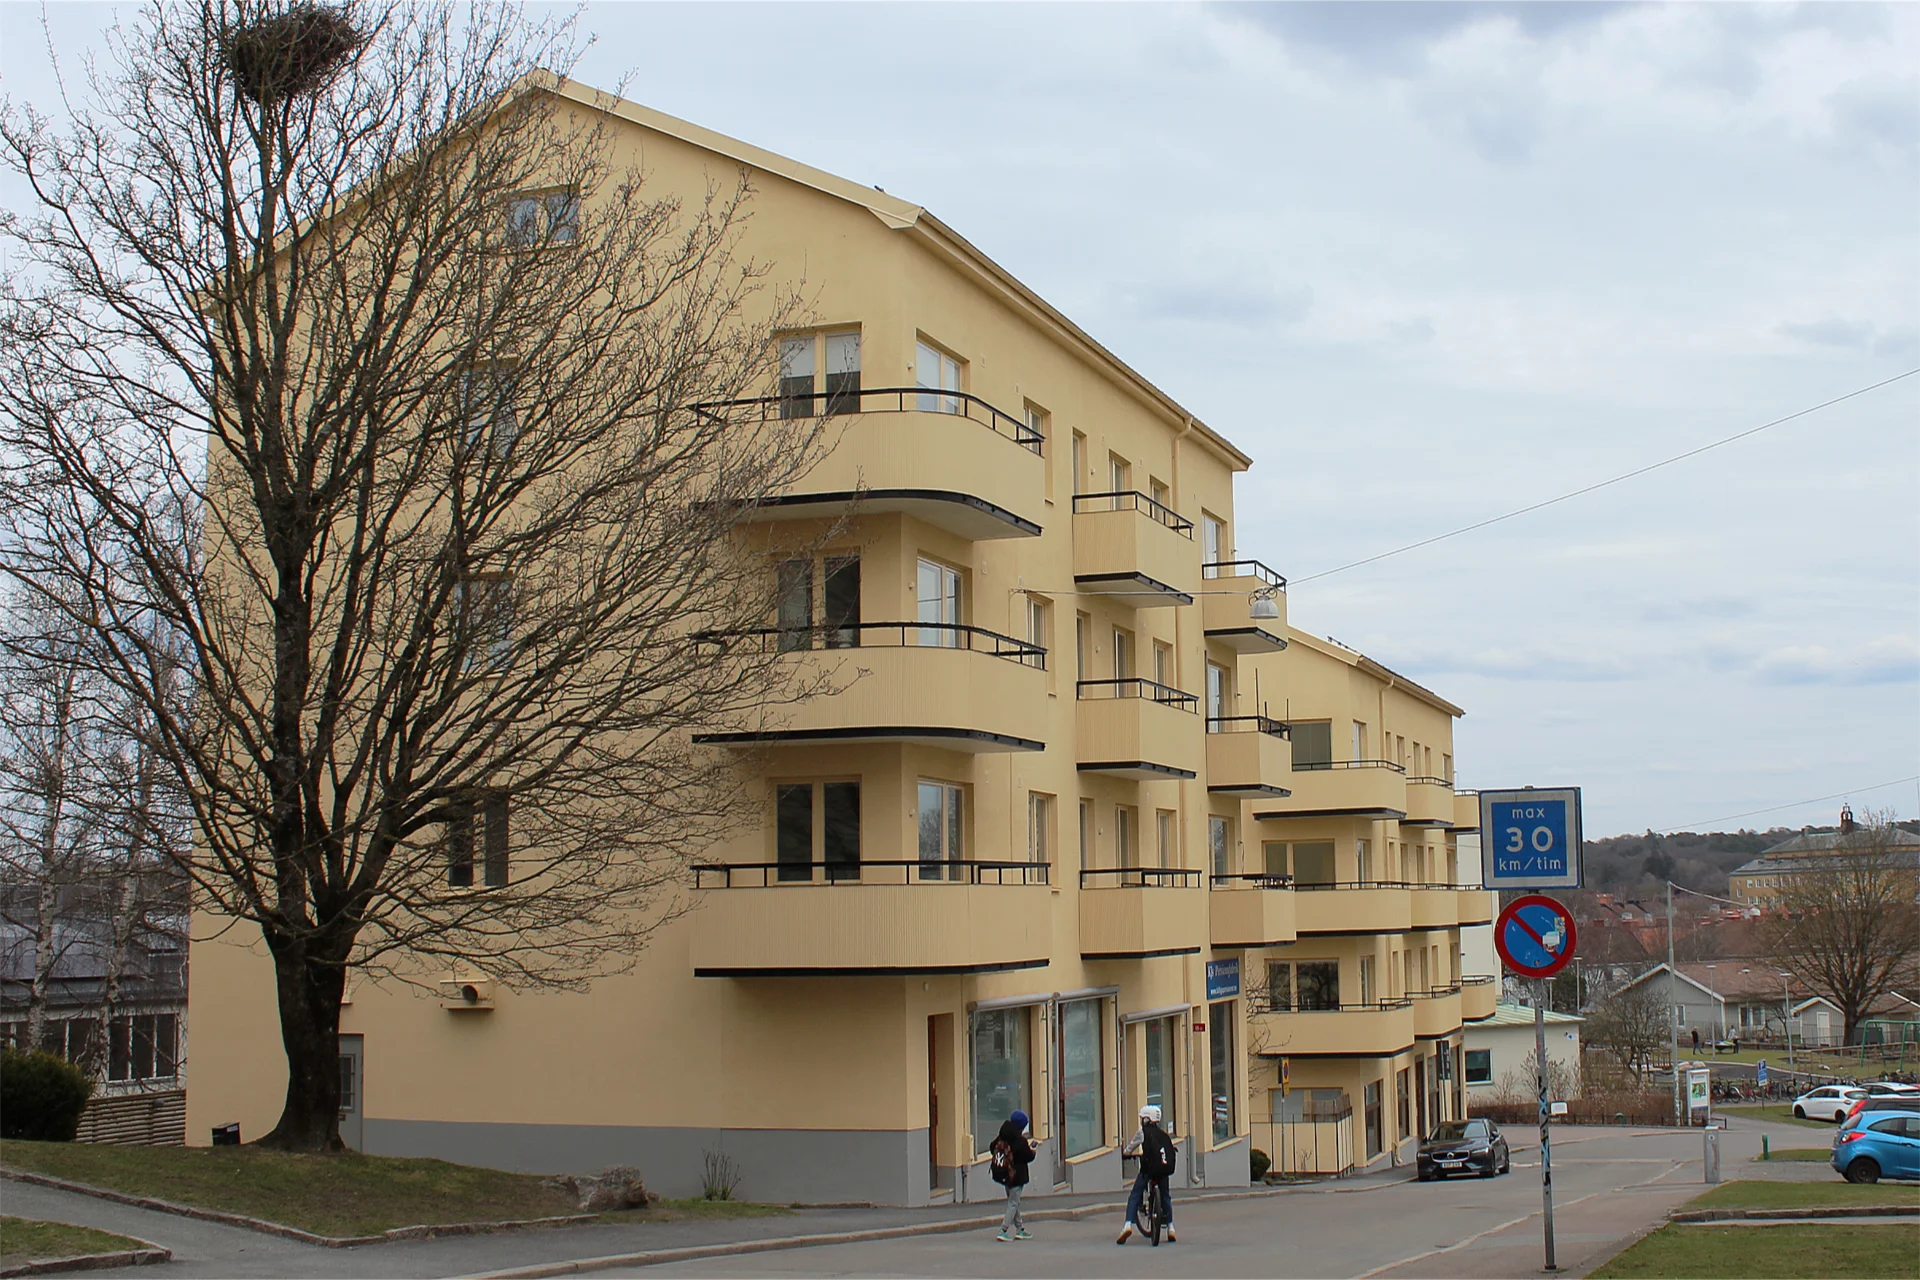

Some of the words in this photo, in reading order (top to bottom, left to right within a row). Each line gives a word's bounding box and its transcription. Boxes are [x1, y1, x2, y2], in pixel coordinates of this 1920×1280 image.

[1512, 808, 1545, 819] max
[1505, 825, 1554, 853] 30
[1498, 856, 1562, 871] km/tim
